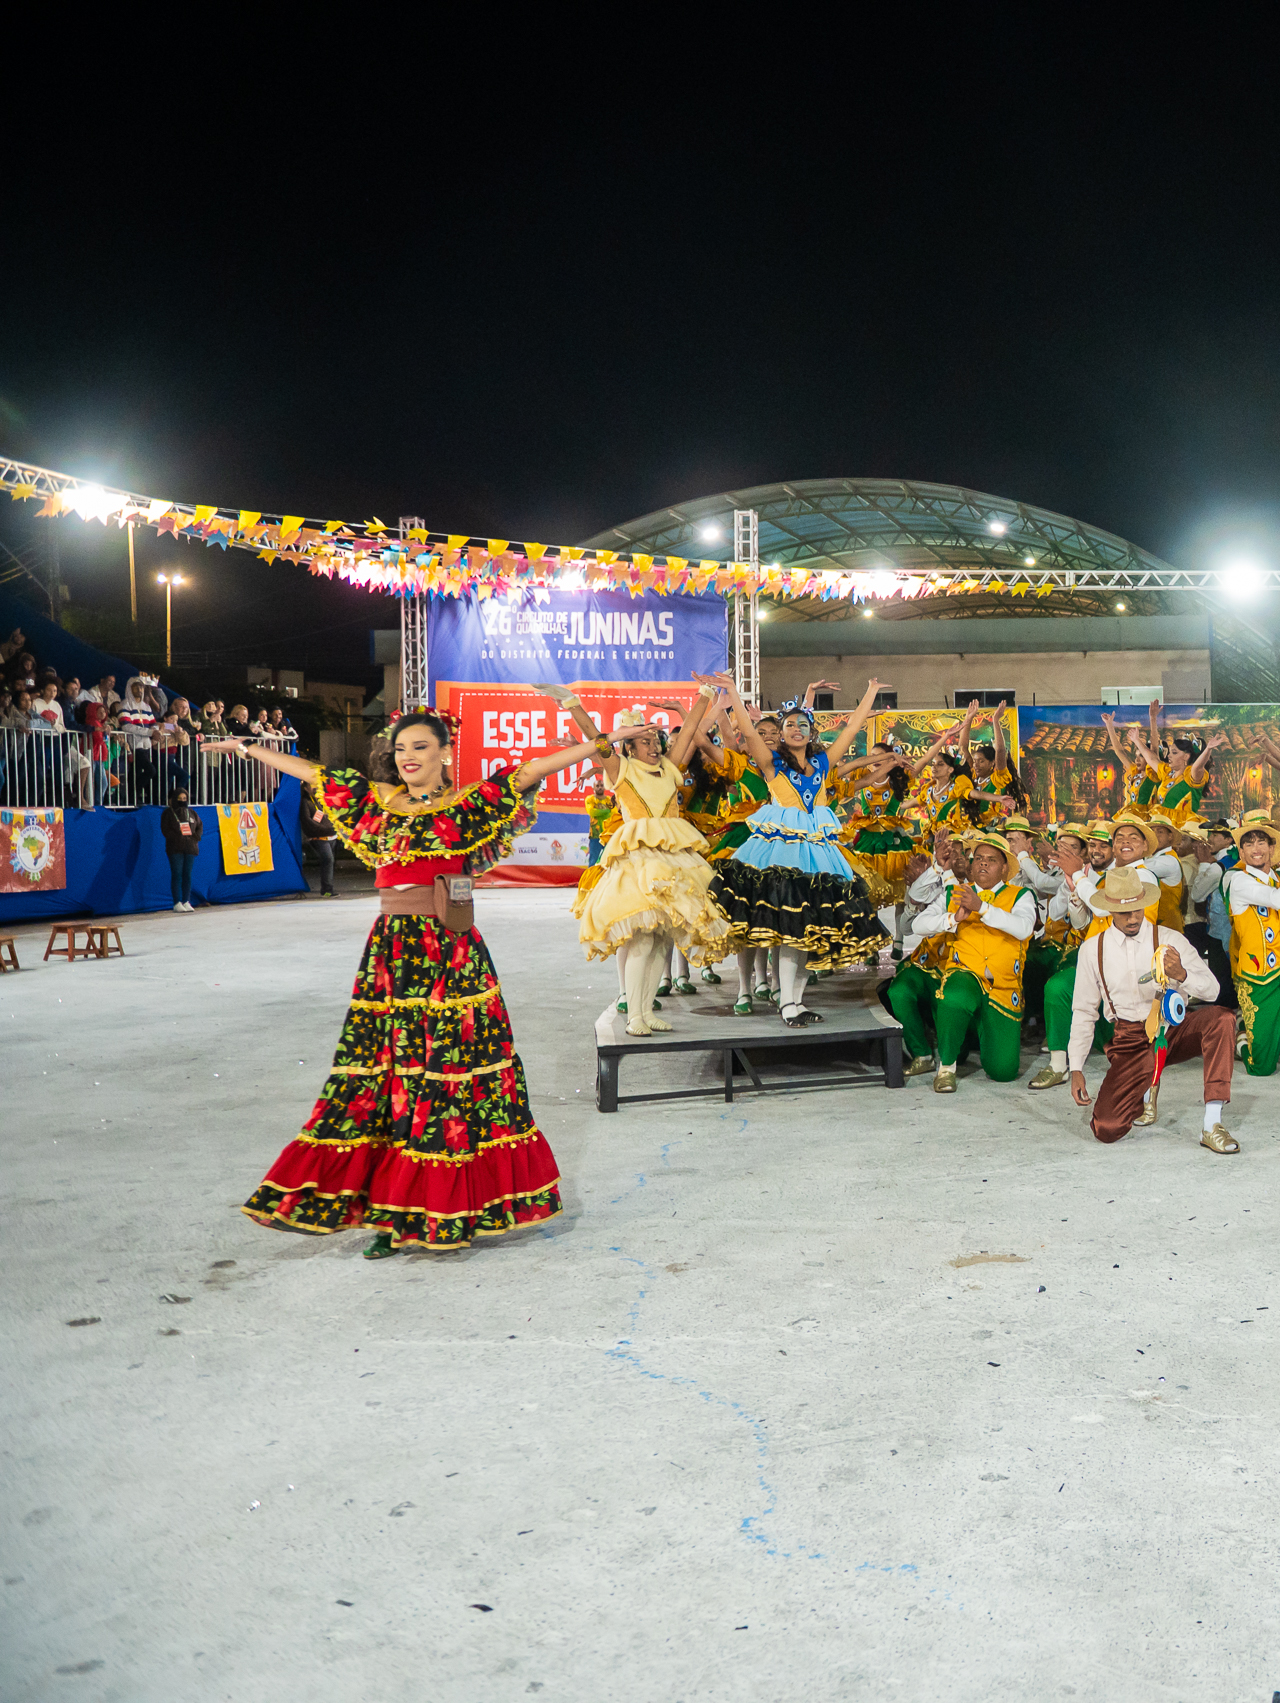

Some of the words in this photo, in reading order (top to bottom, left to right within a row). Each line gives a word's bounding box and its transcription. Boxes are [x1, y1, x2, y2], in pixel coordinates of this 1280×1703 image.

[516, 611, 554, 623] CIRCUITO
[556, 611, 569, 623] DE
[516, 622, 568, 635] QUADRILHAS
[563, 611, 675, 647] JUNINAS
[481, 650, 494, 659] DO
[500, 650, 551, 660] DISTRITO
[557, 650, 605, 660] FEDERAL
[612, 651, 618, 660] E
[624, 650, 675, 660] ENTORNO
[483, 710, 547, 749] ESSE
